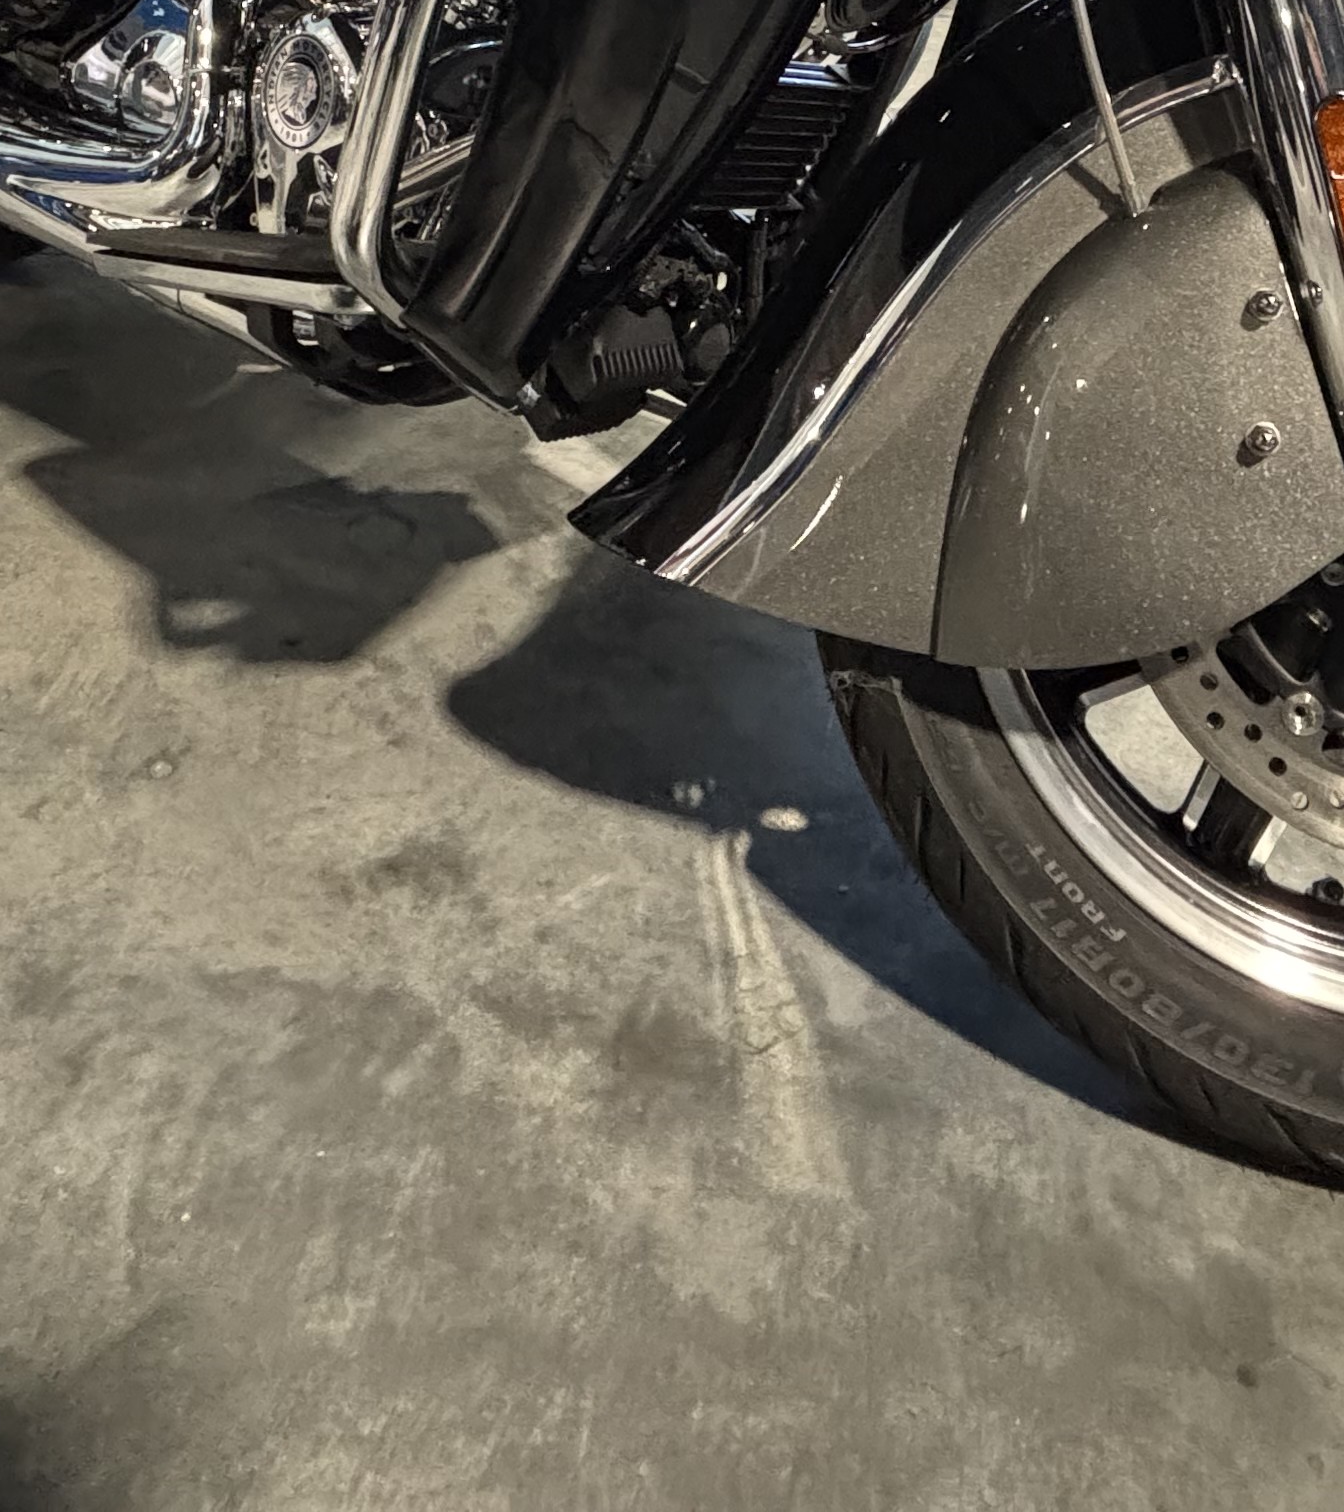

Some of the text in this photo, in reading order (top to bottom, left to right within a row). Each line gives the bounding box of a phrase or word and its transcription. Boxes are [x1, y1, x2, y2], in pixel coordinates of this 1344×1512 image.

[267, 38, 332, 131] INDIAN MOTORCYCLE
[280, 127, 304, 143] 1901
[1026, 842, 1127, 942] FRONT
